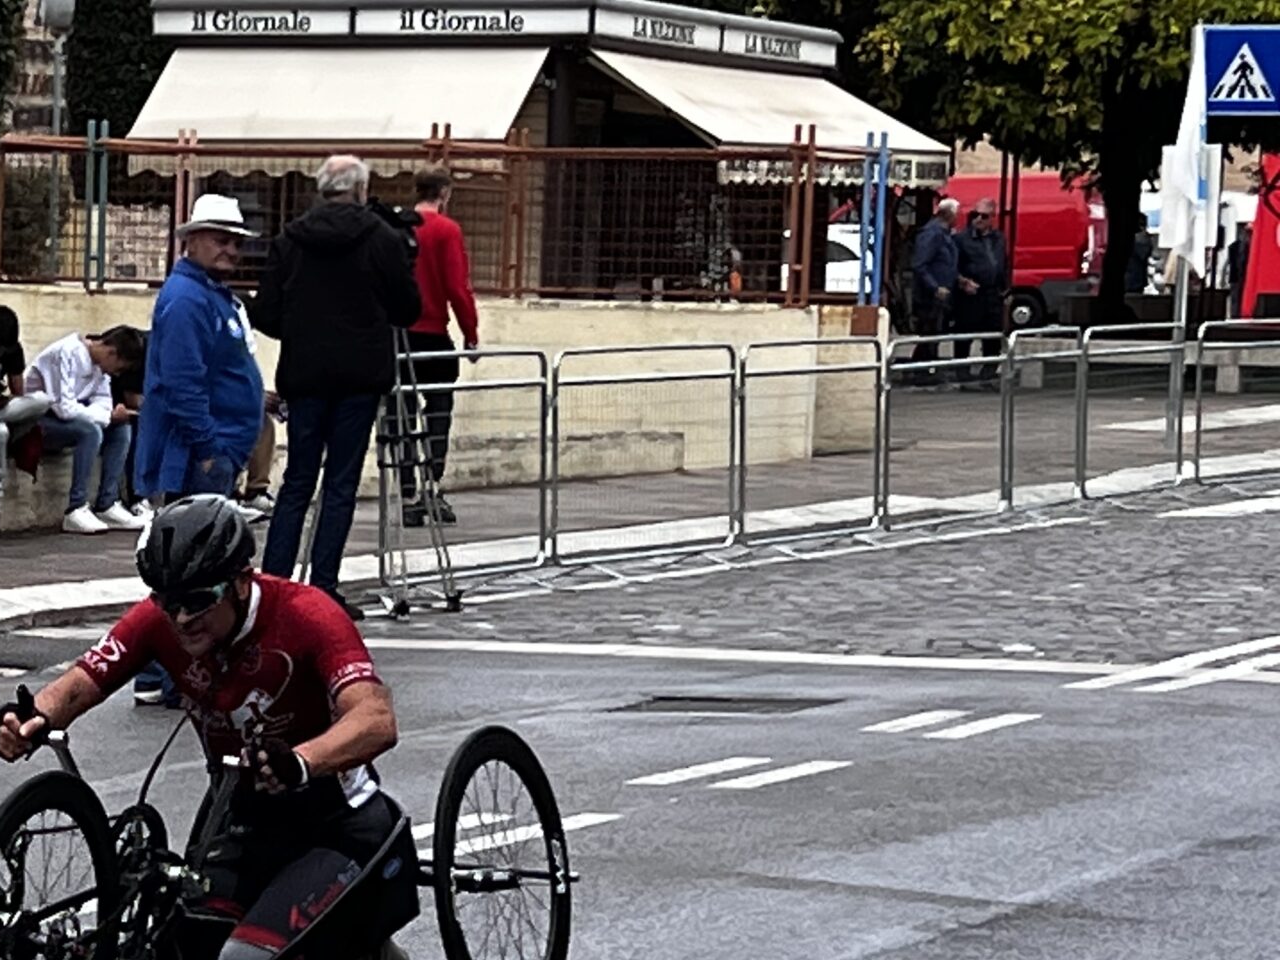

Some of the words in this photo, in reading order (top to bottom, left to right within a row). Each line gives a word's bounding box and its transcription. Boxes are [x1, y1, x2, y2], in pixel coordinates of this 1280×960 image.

[191, 10, 208, 31] il
[212, 10, 312, 33] Giornale
[399, 9, 416, 31] il
[420, 9, 525, 33] Giornale
